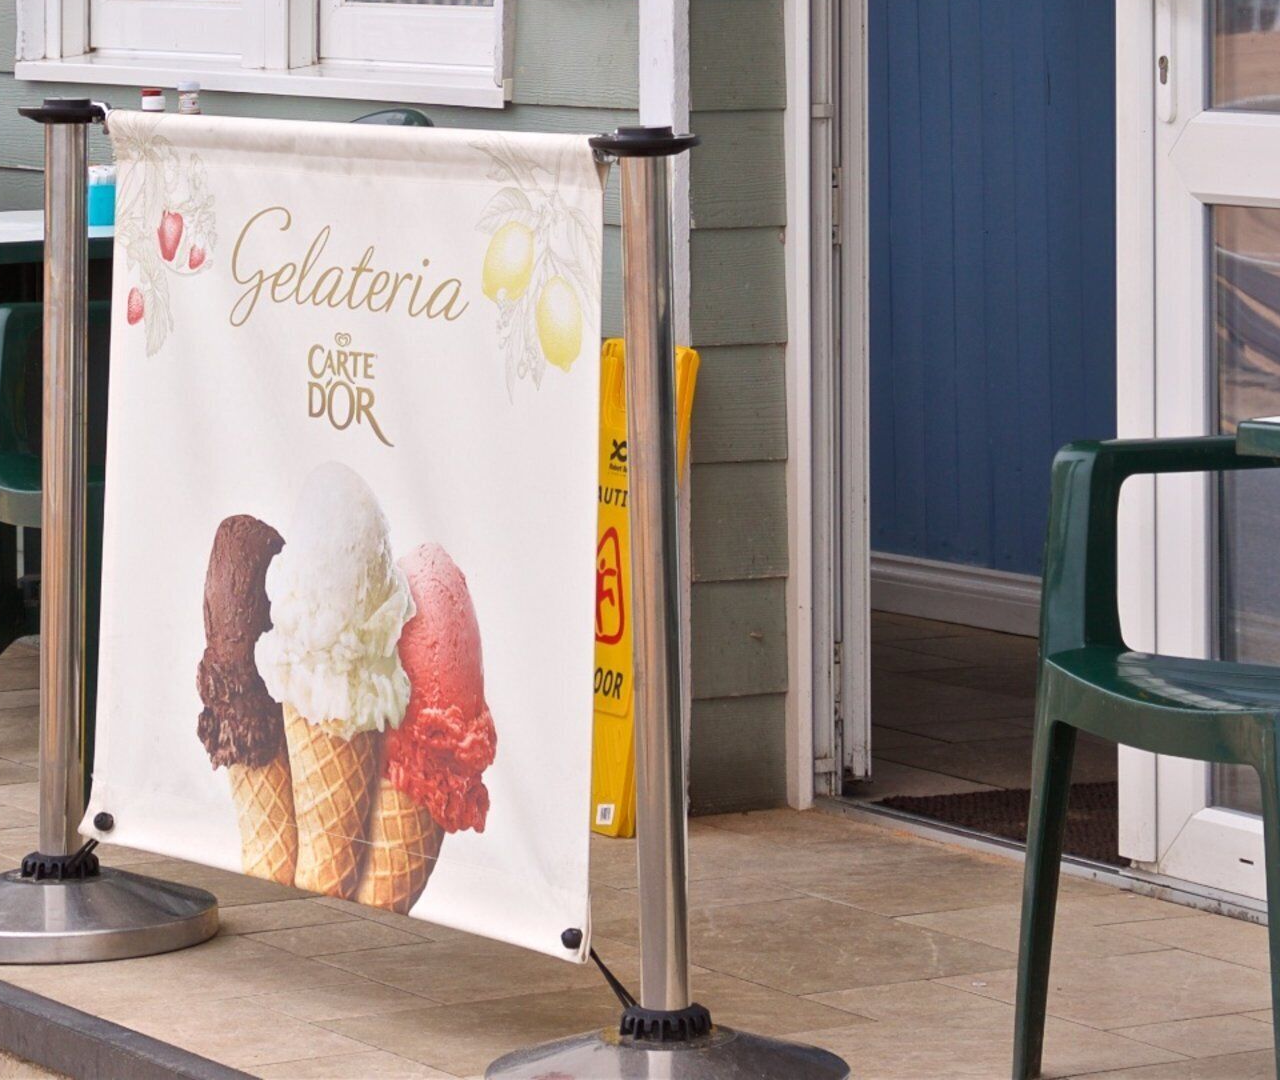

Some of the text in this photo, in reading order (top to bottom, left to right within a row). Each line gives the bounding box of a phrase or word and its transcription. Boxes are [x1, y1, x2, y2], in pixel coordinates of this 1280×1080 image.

[229, 205, 470, 327] Gelateria
[307, 343, 376, 384] CARTE
[307, 377, 395, 447] D'OR
